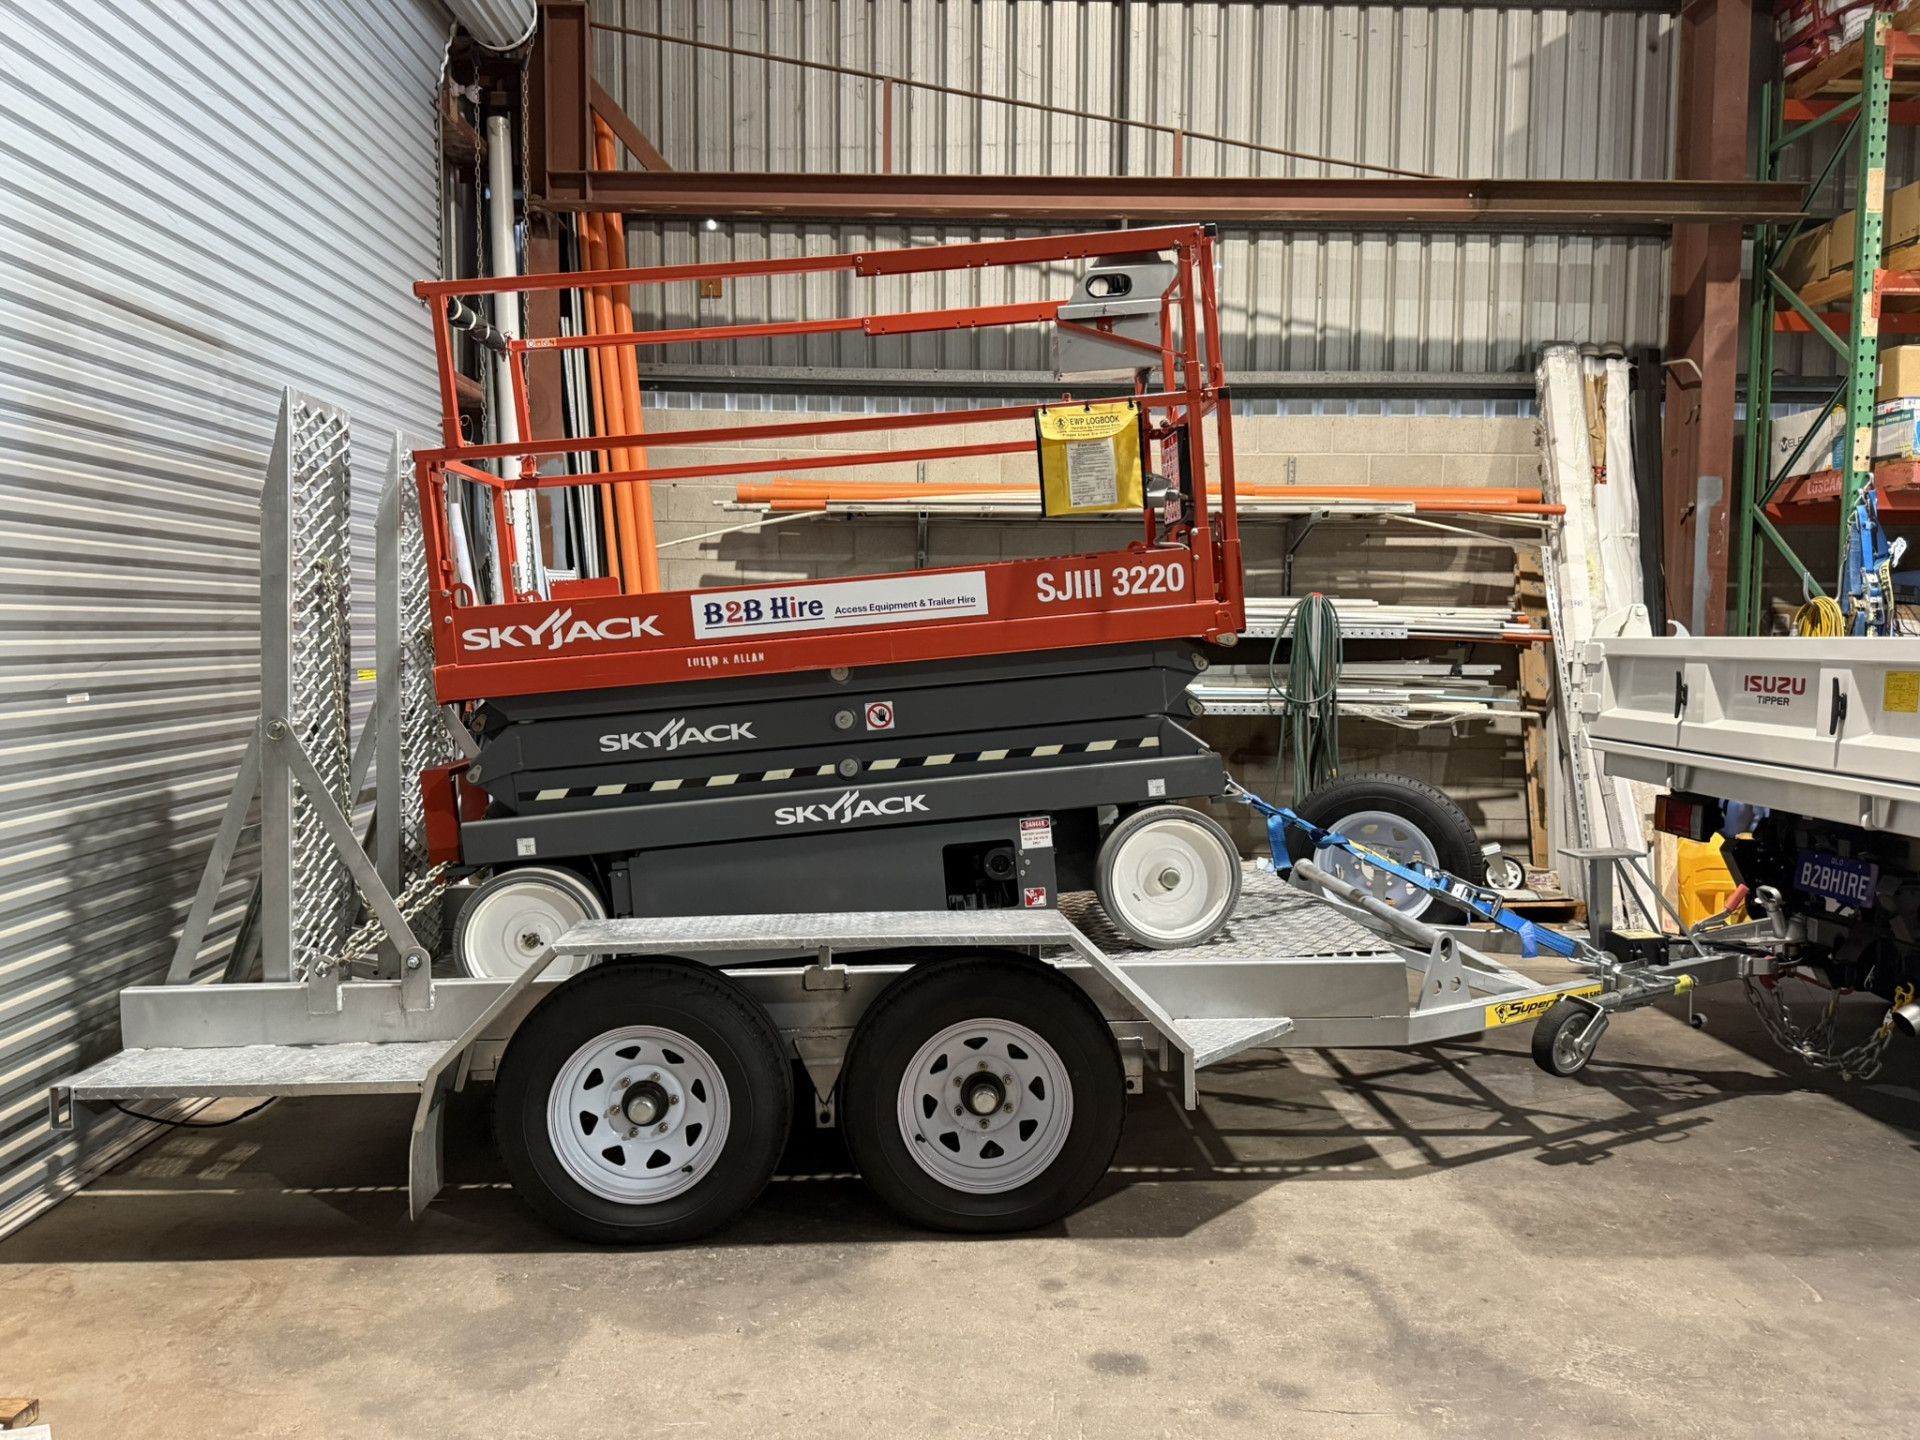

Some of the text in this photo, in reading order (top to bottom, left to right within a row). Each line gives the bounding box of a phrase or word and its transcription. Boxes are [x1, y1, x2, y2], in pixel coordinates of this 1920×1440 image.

[1069, 415, 1120, 425] EWP LOGBOOK
[1036, 562, 1185, 602] SJIII 3220
[703, 596, 824, 625] B2B Hire
[834, 594, 976, 614] Access Equipment & Trailer Hire
[462, 607, 664, 651] SKYJACK
[1744, 675, 1806, 695] ISUZU
[1757, 695, 1790, 706] TIPPER
[599, 717, 757, 752] SKYJACK
[774, 790, 930, 825] SKYJACK
[1801, 861, 1871, 901] B2BHIRE
